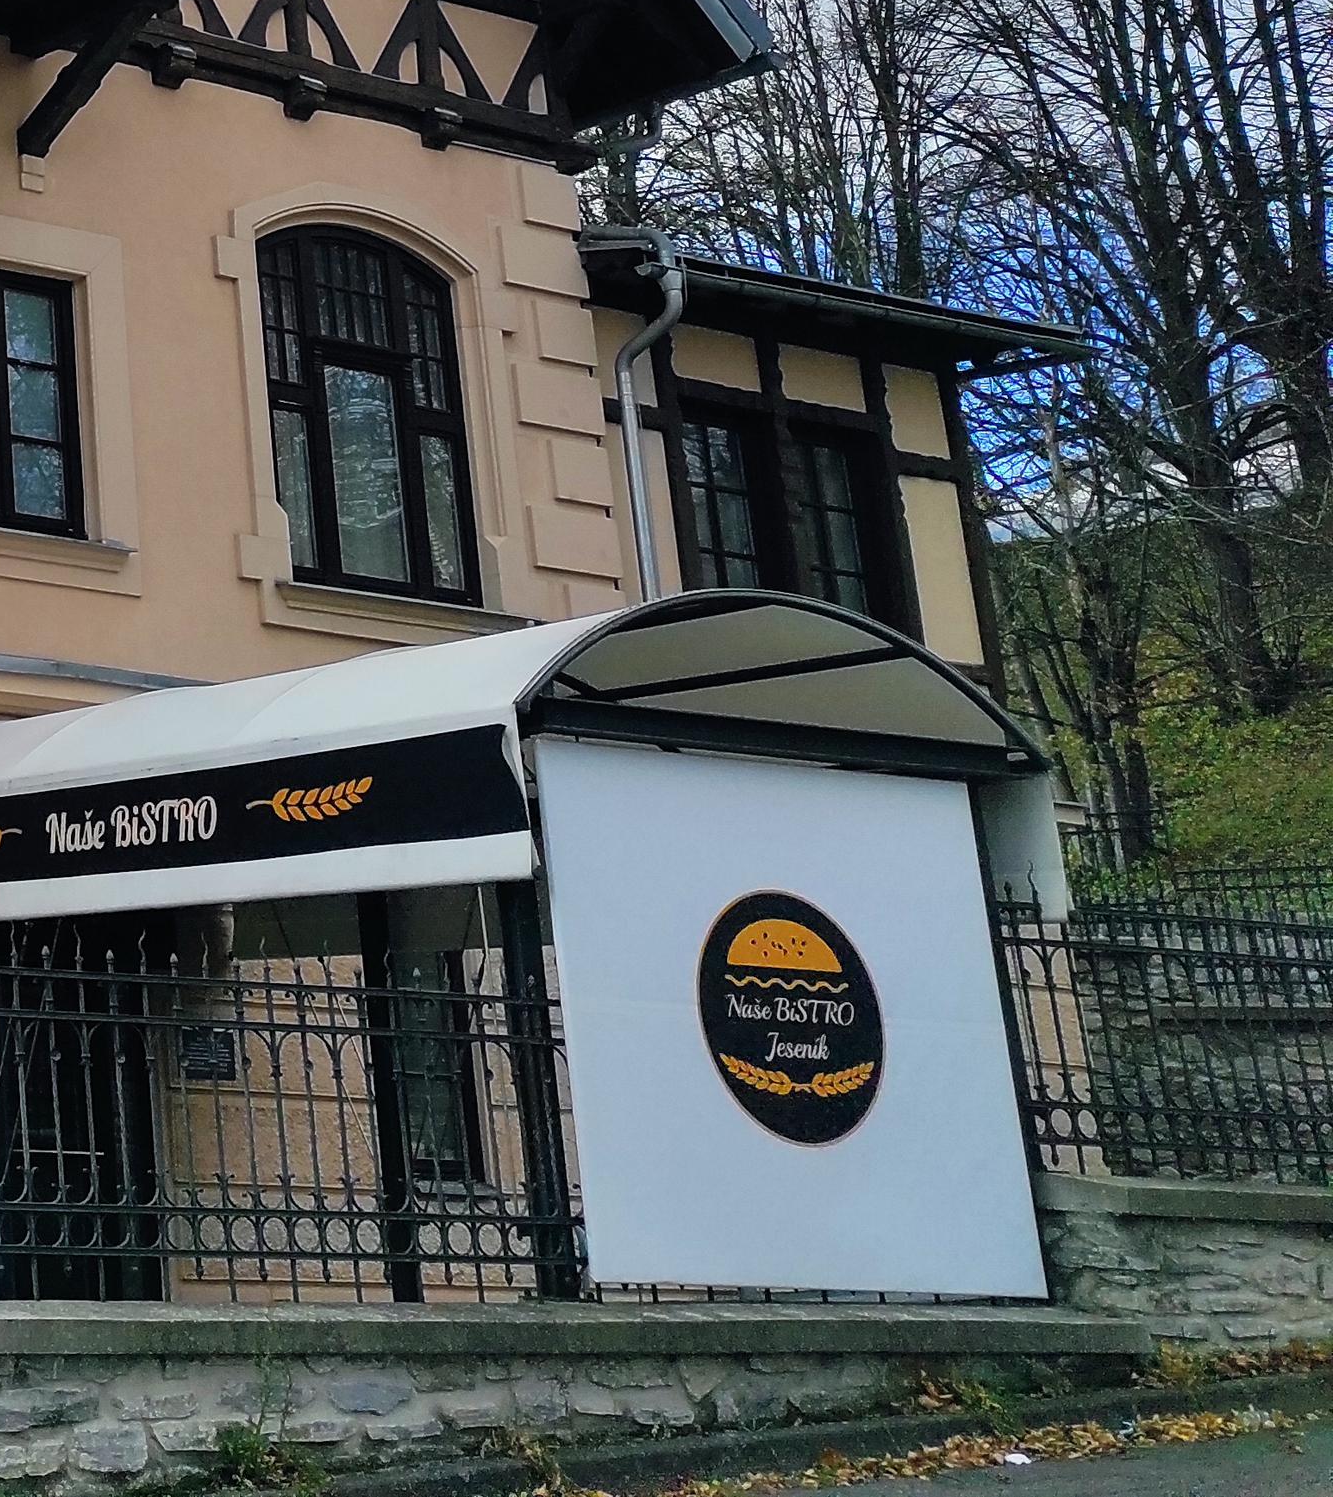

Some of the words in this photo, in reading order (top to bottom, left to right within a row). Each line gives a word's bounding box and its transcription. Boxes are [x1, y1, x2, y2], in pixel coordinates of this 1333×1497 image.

[45, 808, 106, 854] Naše
[110, 795, 218, 848] BiSTRO
[725, 994, 772, 1020] Naše
[774, 997, 855, 1026] BiSTRO
[765, 1032, 830, 1062] Jeseník
